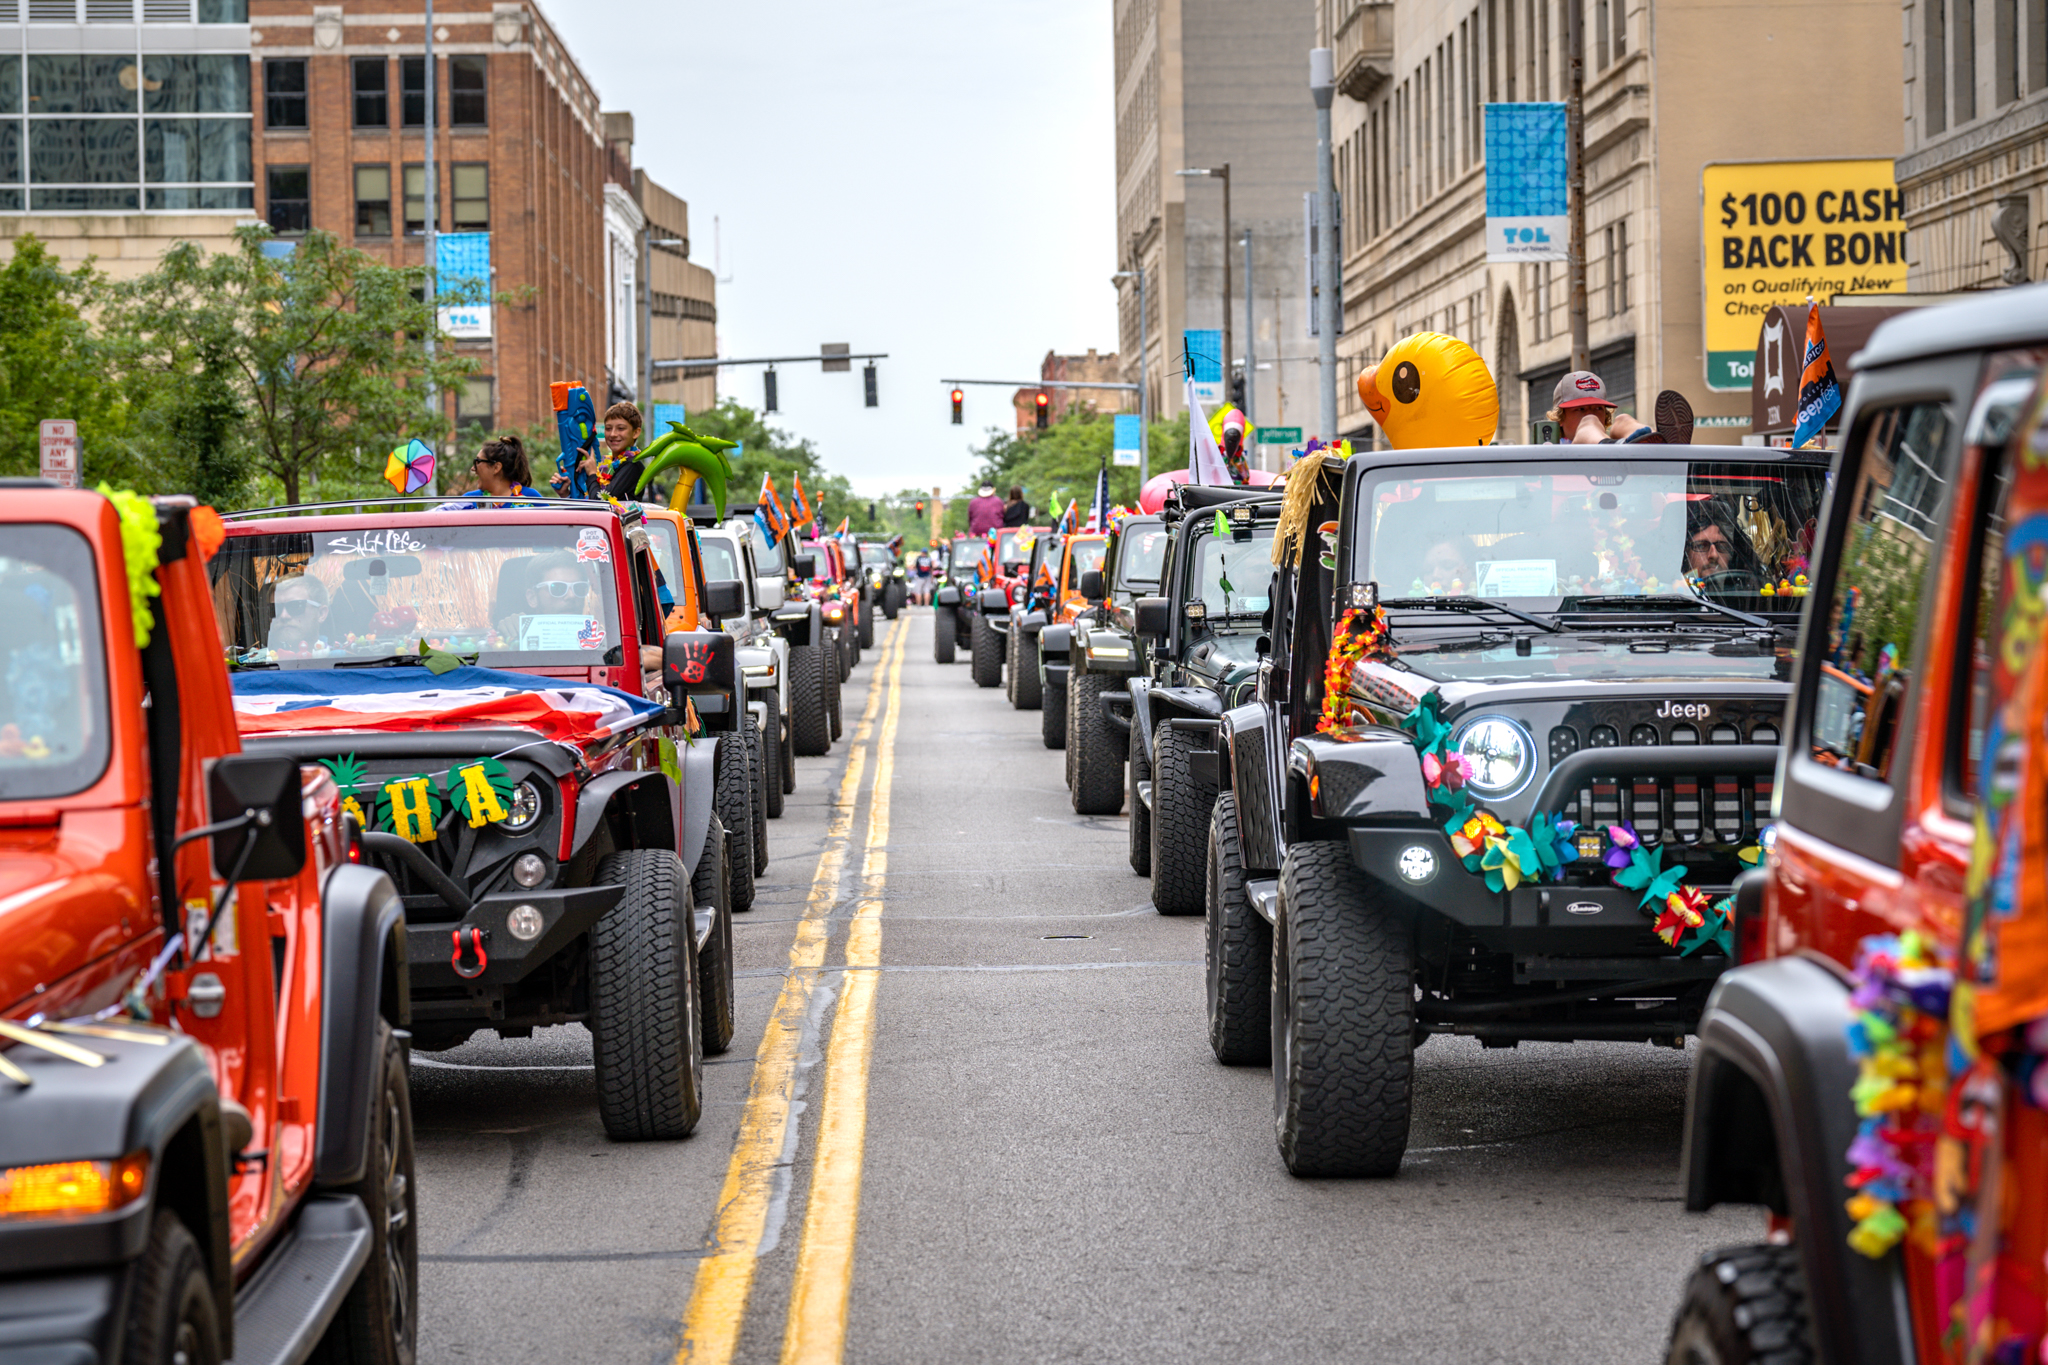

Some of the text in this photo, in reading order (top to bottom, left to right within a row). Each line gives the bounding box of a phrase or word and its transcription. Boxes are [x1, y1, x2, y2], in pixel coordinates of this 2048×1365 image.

[1721, 188, 1905, 229] $100 CASH
[1503, 227, 1550, 244] TOL
[1723, 234, 1814, 269] BACK
[1724, 275, 1892, 296] on Qualifying New
[449, 315, 479, 325] TOL
[1696, 416, 1749, 427] LAMAR
[52, 425, 65, 435] NO
[42, 437, 76, 446] STOPPING
[50, 448, 67, 457] ANY
[49, 459, 68, 468] TIME
[1656, 700, 1711, 721] Jeep
